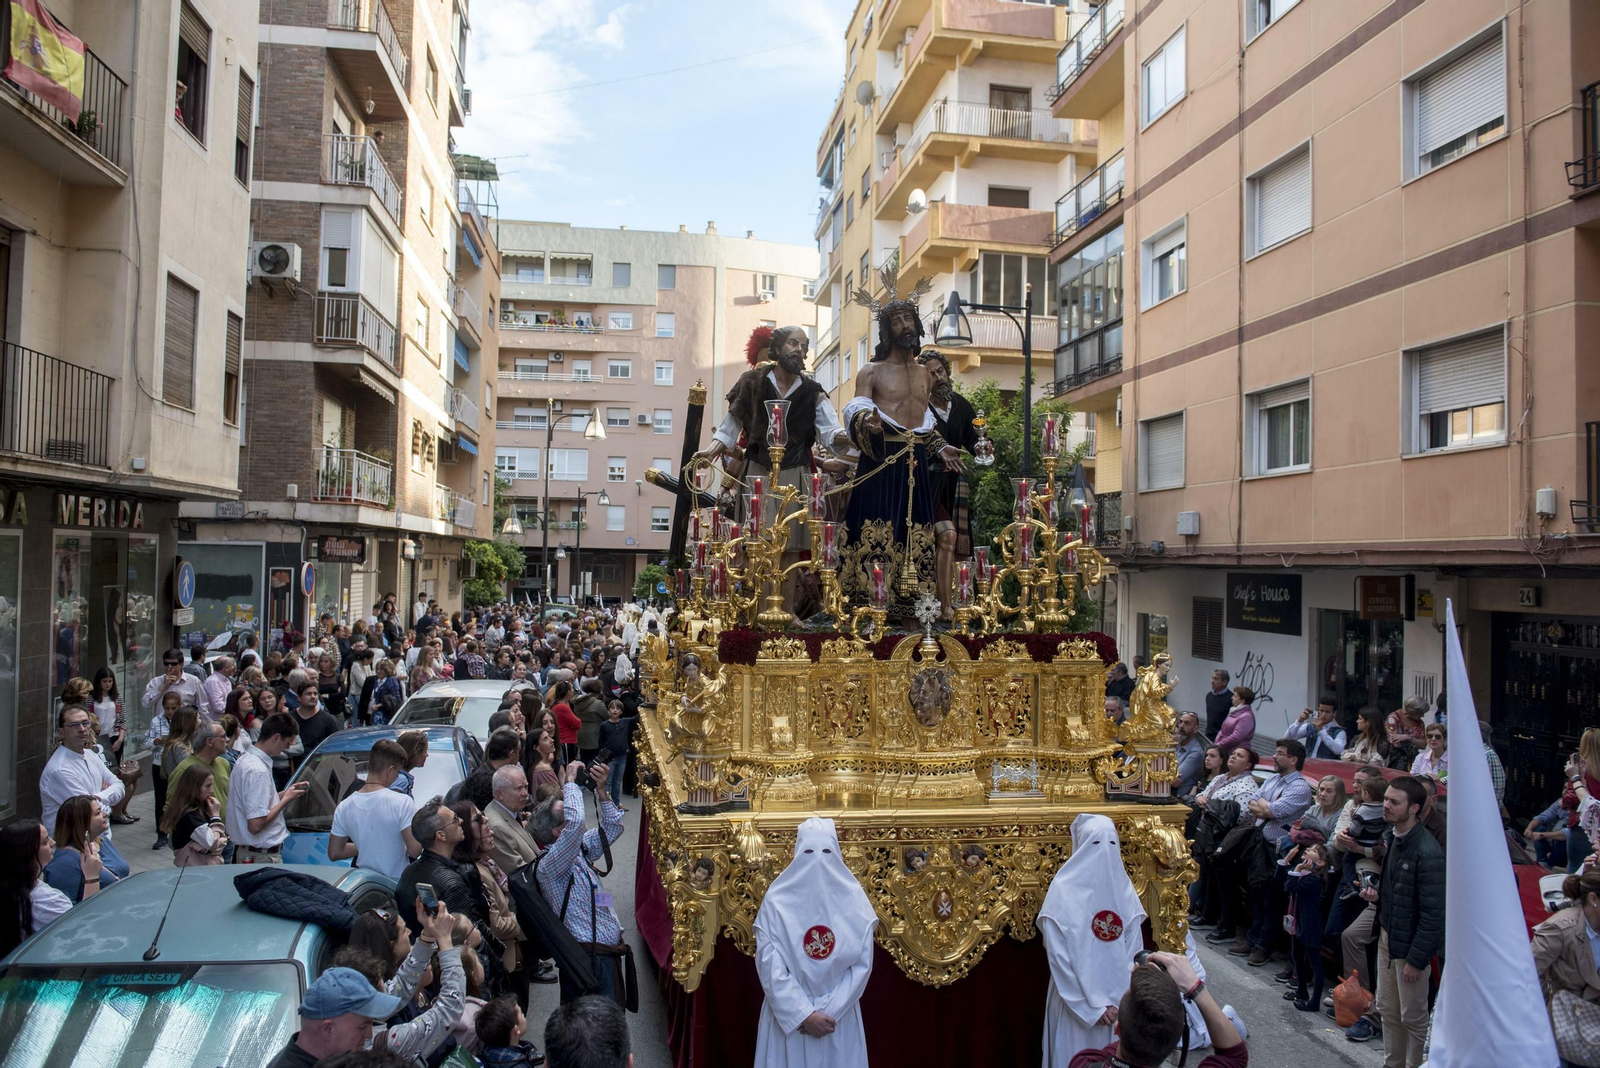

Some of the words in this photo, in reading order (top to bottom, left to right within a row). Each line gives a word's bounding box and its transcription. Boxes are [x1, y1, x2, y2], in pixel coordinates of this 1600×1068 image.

[0, 489, 28, 525] A
[57, 493, 145, 529] MERIDA
[1260, 584, 1291, 602] House
[1519, 589, 1532, 604] 24
[1547, 625, 1563, 638] 24
[113, 973, 145, 983] CHICA
[148, 972, 177, 982] SEXY
